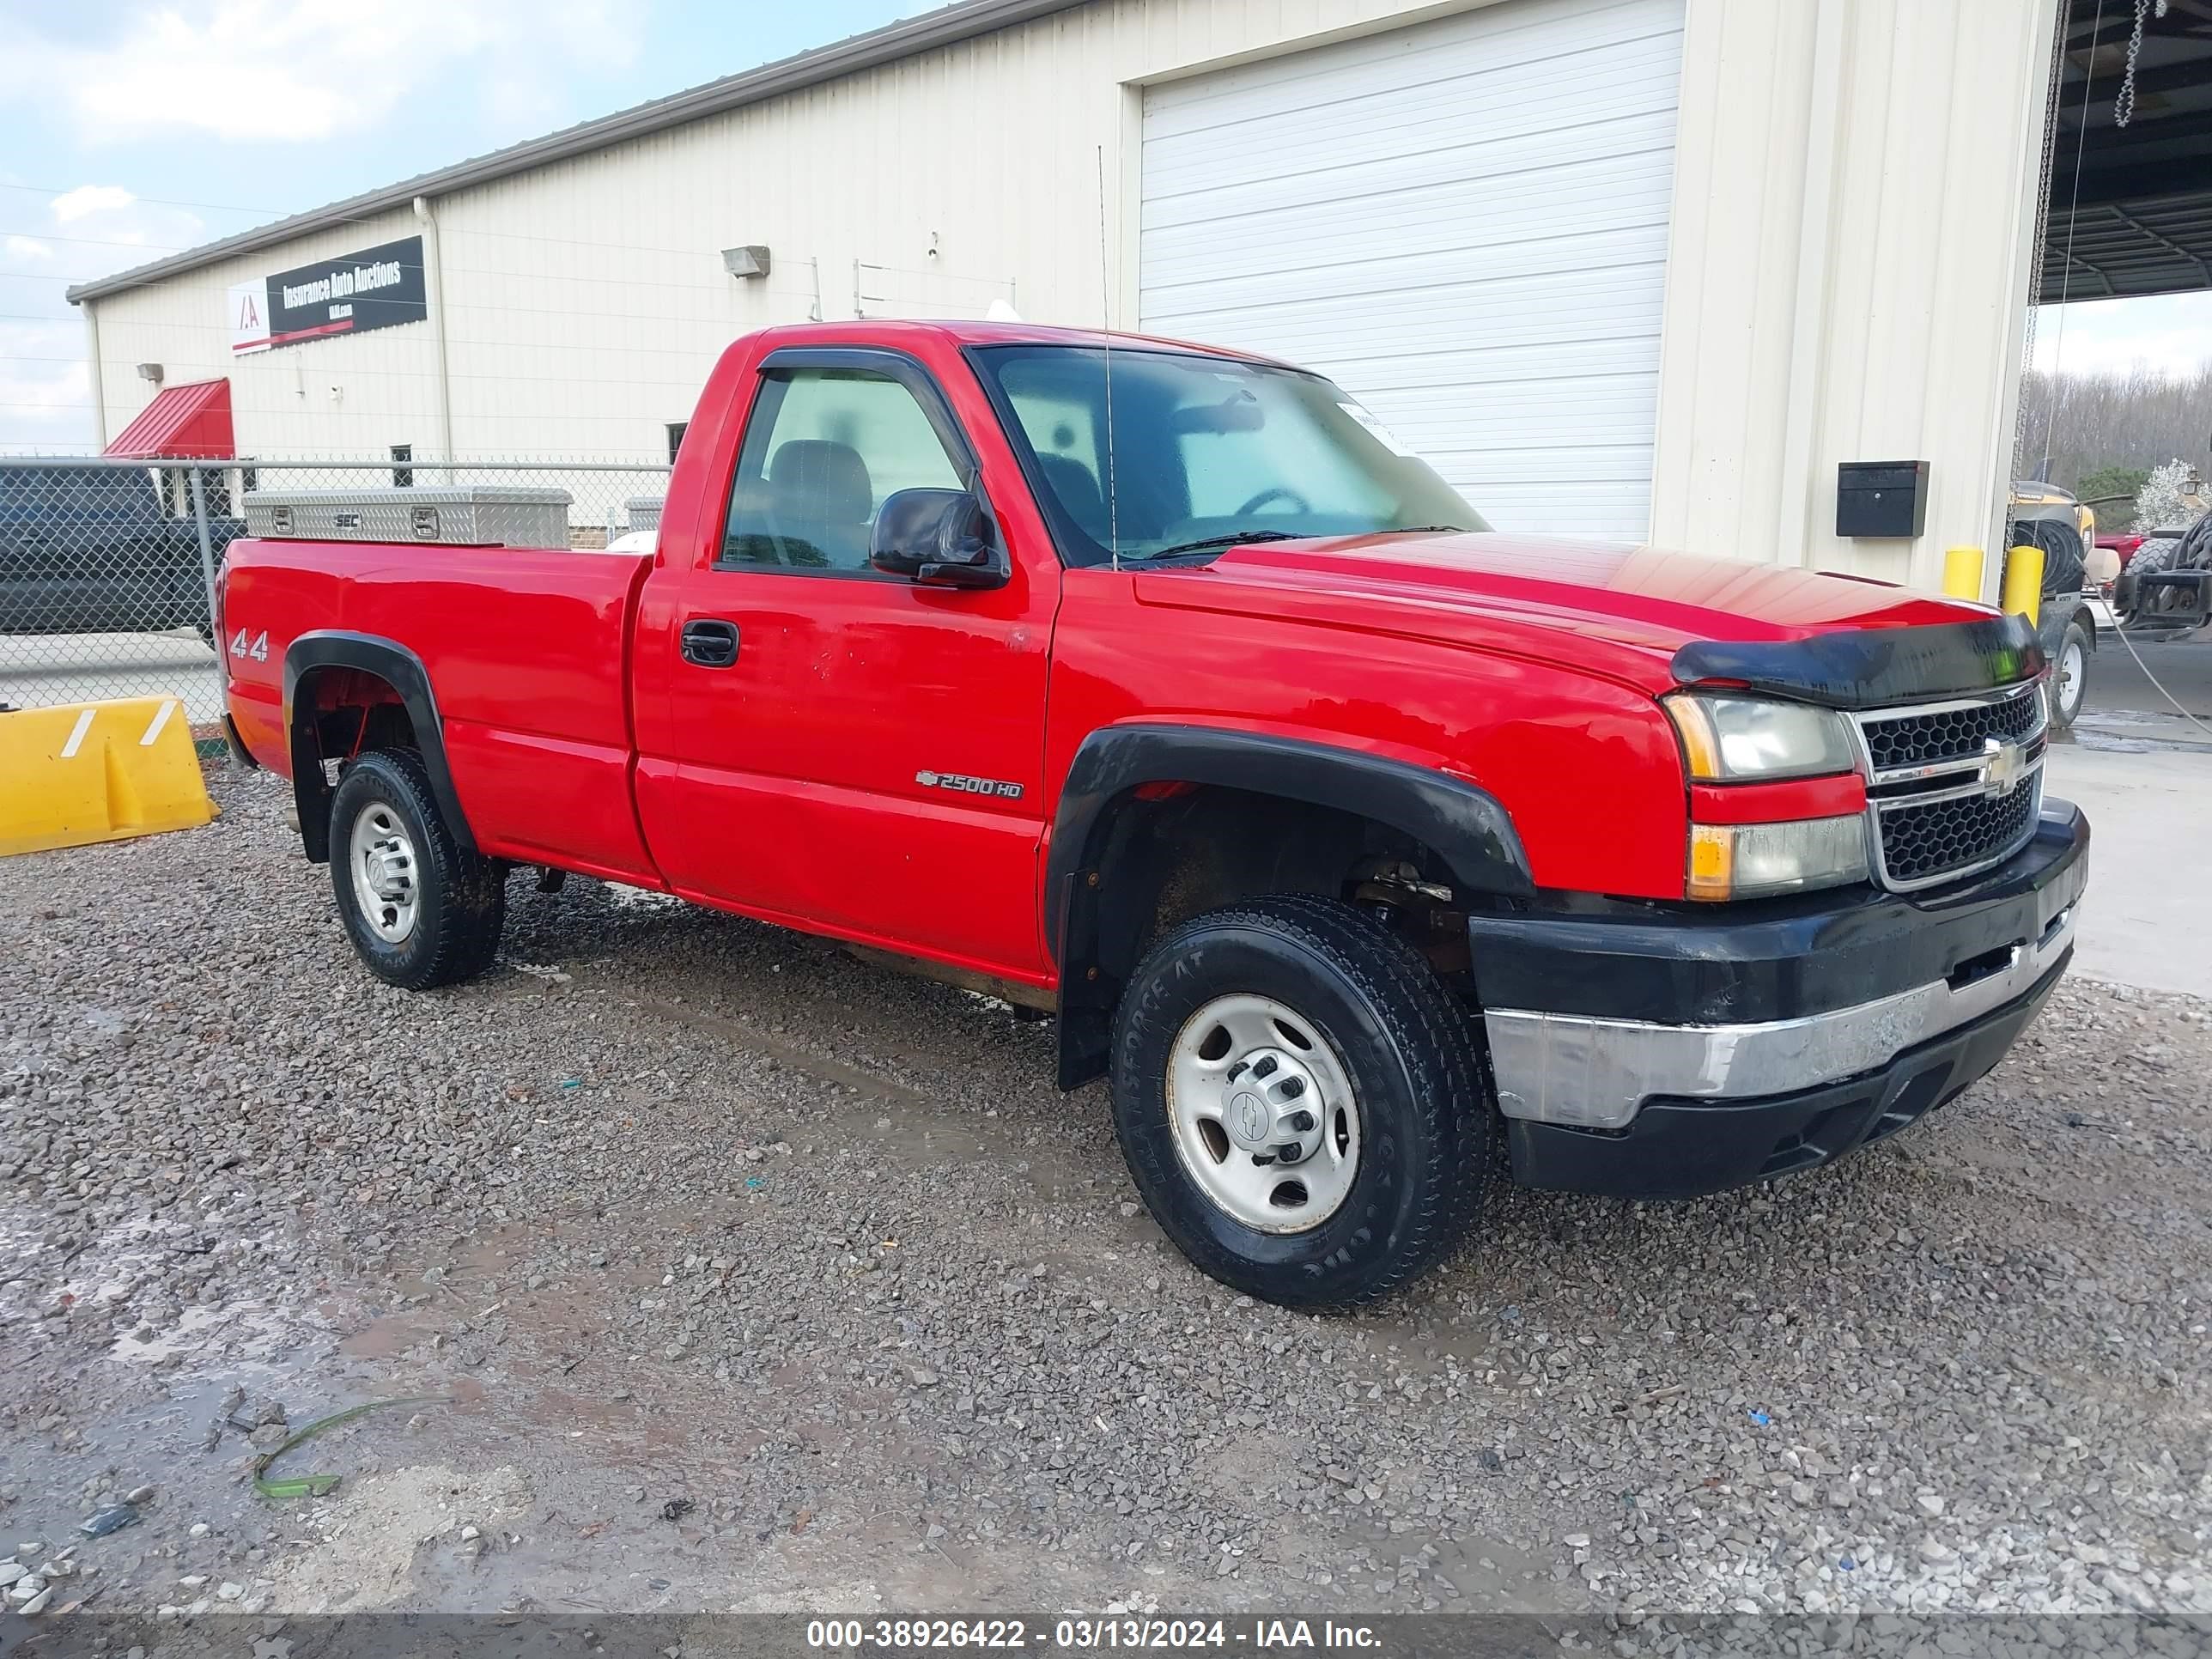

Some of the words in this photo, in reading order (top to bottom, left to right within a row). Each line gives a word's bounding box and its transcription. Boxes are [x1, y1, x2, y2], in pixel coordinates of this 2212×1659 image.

[283, 278, 331, 310] Insurance
[331, 272, 354, 298] Auto
[354, 260, 401, 293] Auctions
[336, 514, 359, 528] SEC
